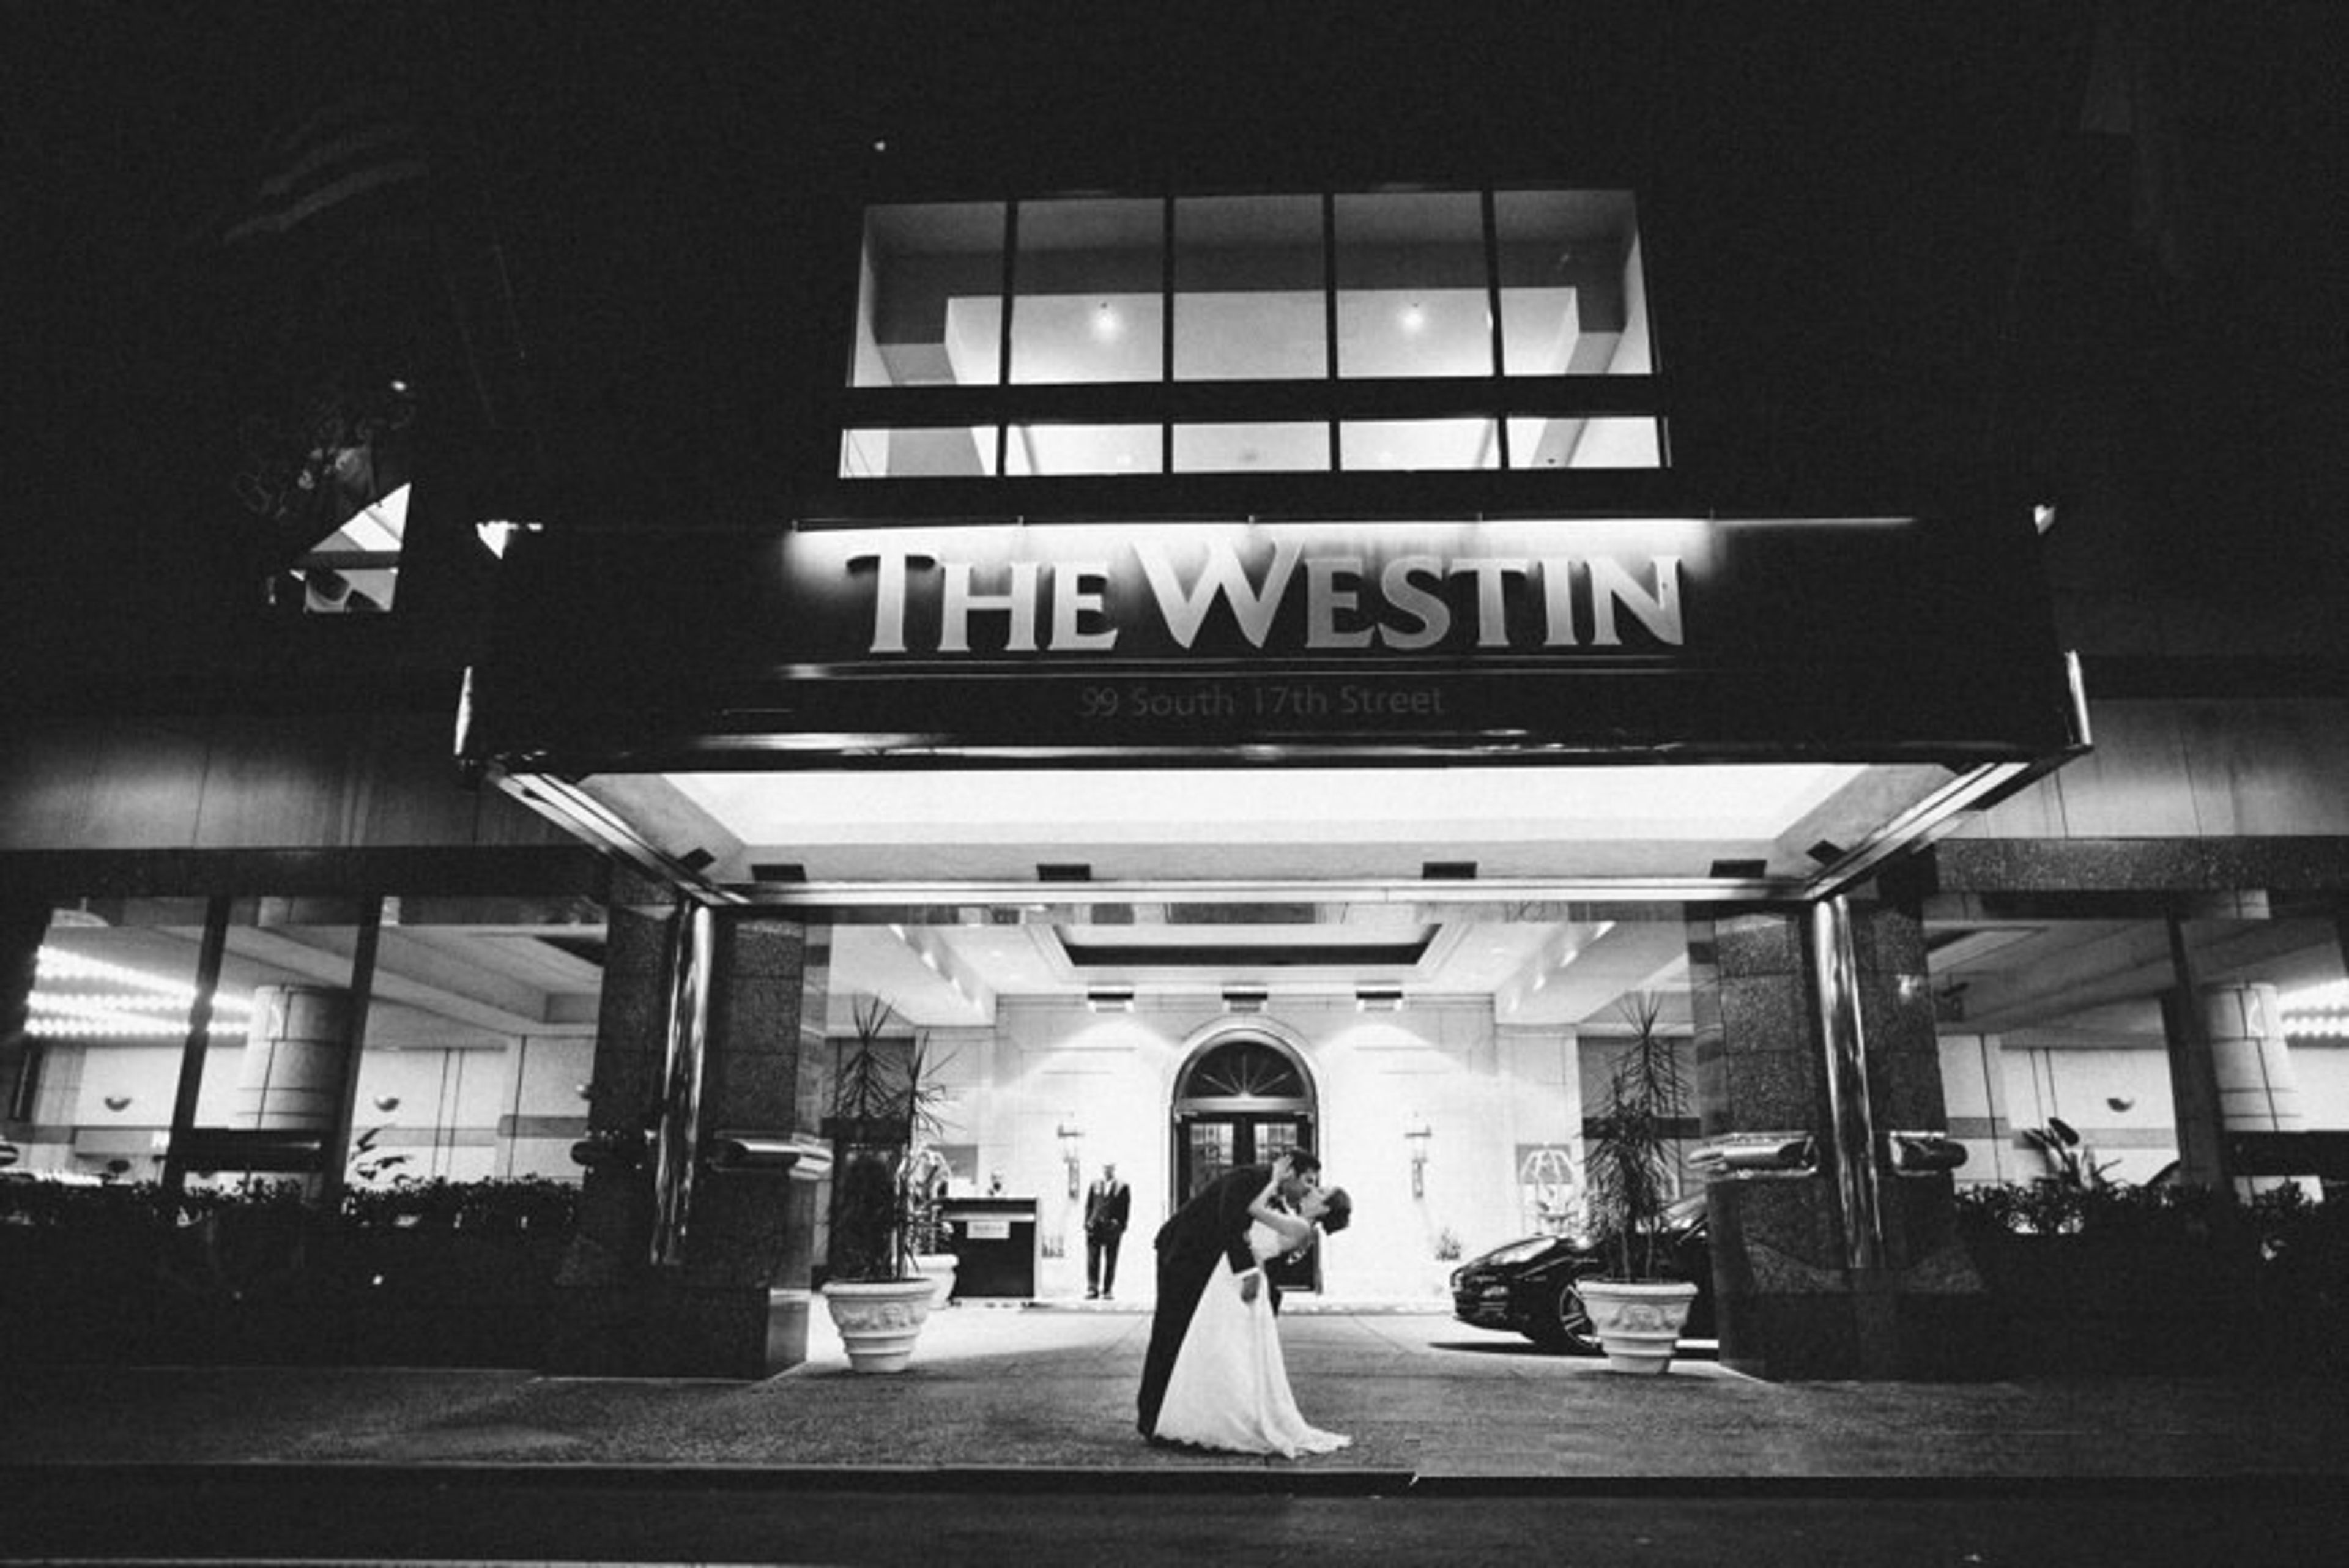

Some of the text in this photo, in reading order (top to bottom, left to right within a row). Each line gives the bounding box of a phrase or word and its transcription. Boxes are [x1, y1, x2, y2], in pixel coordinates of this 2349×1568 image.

[845, 536, 1683, 653] THE WESTIN
[1080, 685, 1445, 717] 99 South 17th Street
